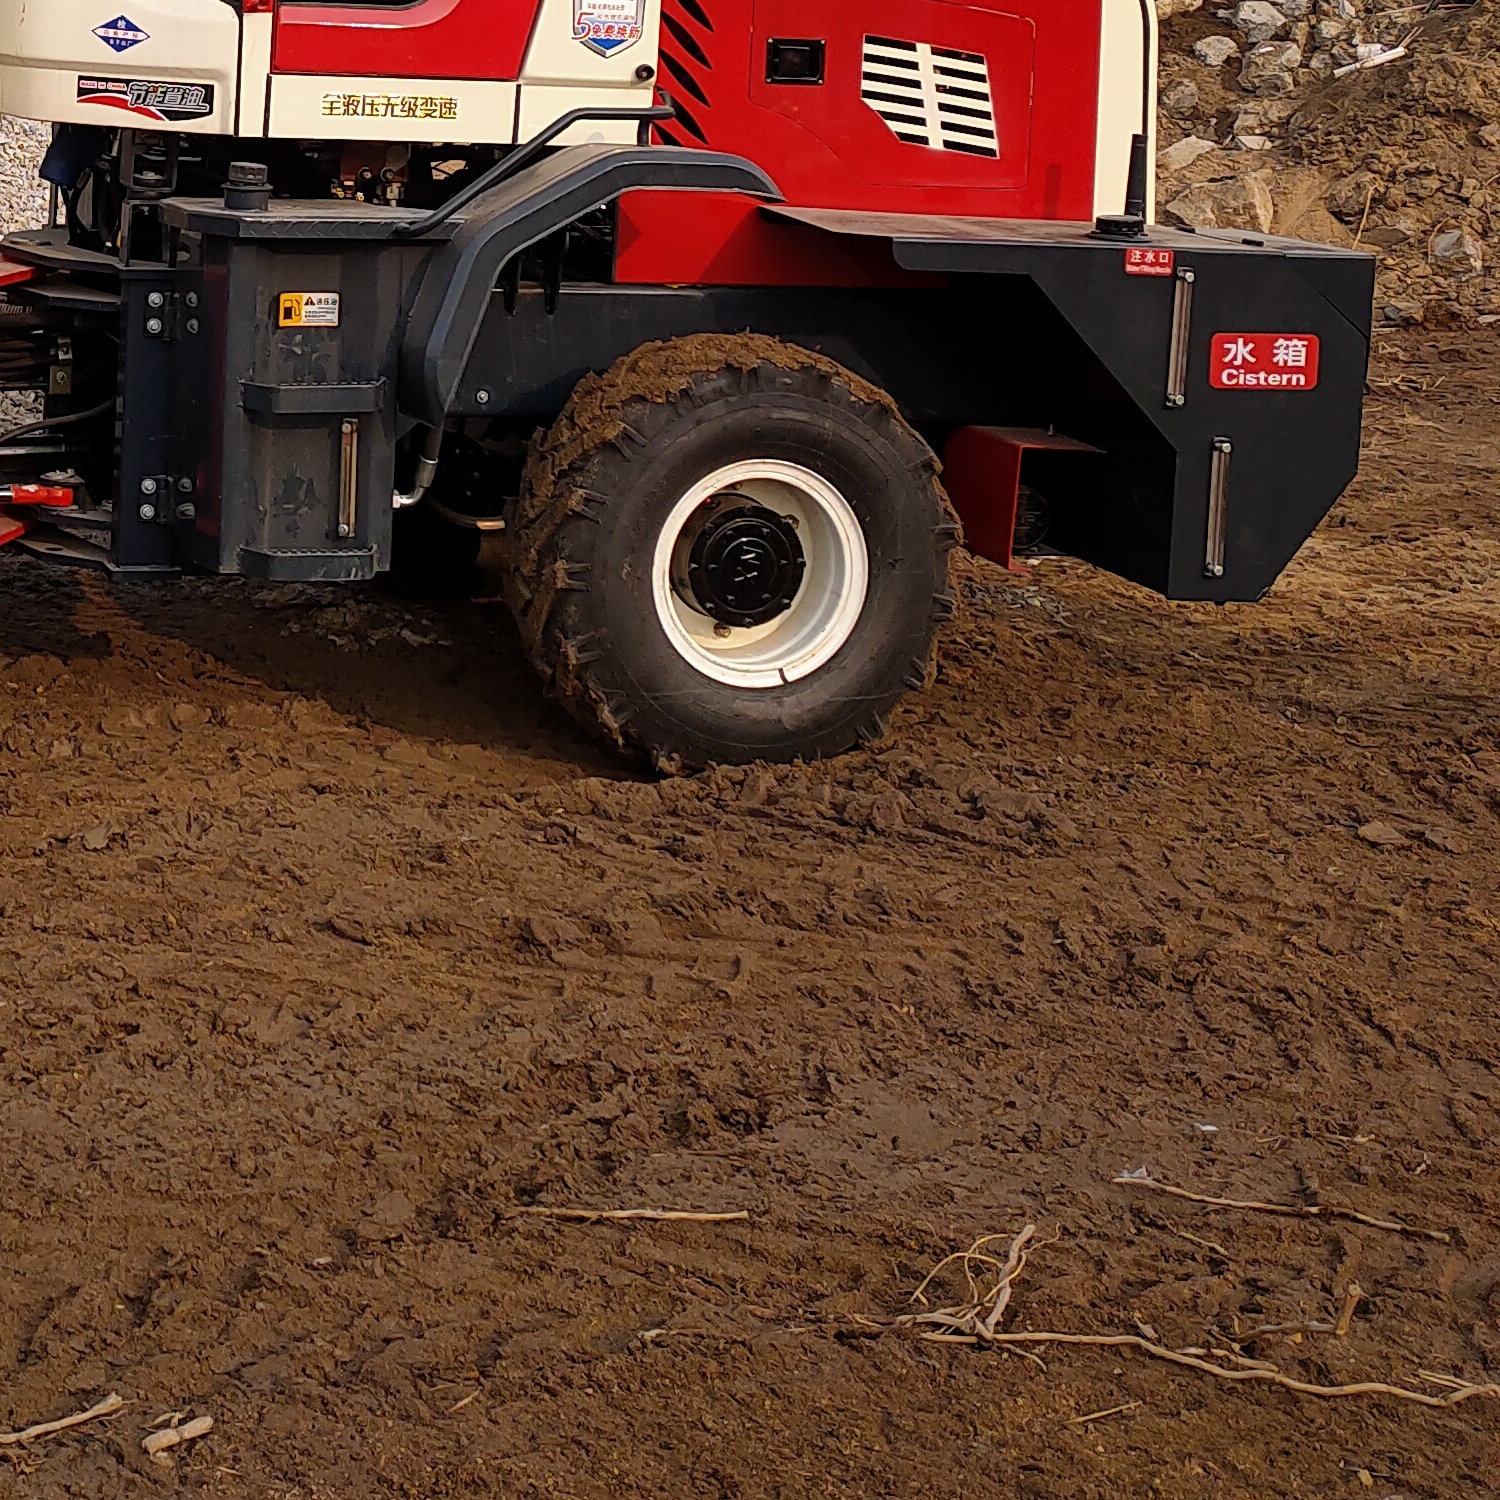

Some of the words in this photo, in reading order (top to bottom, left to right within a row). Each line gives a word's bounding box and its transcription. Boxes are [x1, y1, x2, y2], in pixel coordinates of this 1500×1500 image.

[571, 11, 595, 40] 5
[129, 83, 203, 106] 节能省油
[321, 93, 459, 120] 全液压无级变速
[1130, 249, 1170, 264] 注水口
[1222, 337, 1308, 367] 水箱
[1221, 368, 1306, 386] Cistern
